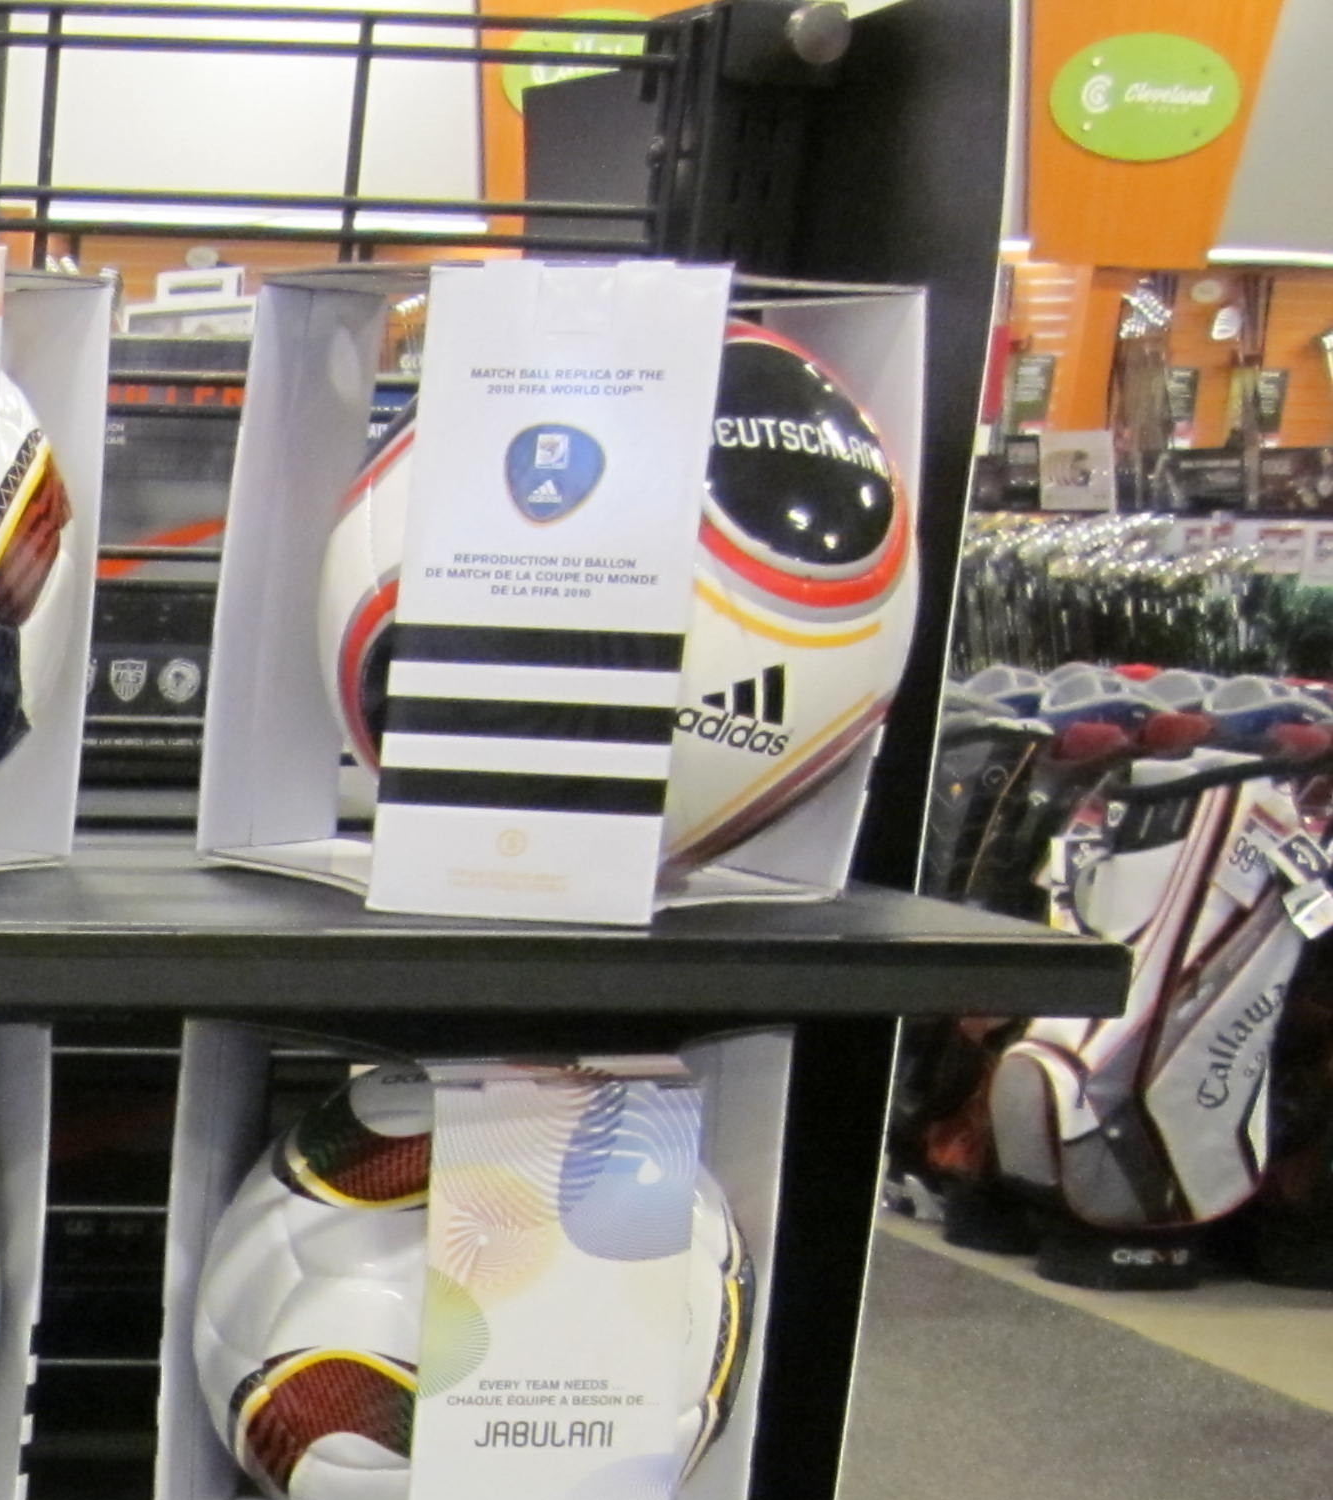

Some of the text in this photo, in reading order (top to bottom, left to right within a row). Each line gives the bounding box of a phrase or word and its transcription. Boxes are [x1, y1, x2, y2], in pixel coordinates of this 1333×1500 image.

[469, 366, 665, 381] MATCH BALL REPLICA OF THE
[486, 383, 515, 395] 2010
[517, 383, 547, 394] FIFA
[549, 383, 601, 395] WORLD
[712, 416, 891, 479] EUTSCHLAND
[452, 552, 637, 569] REPRODUCTION DU BALLON
[424, 566, 659, 585] DE MATCH DE LA COUPE DU MONDE
[489, 583, 591, 598] DE LA FIFA 2010
[675, 707, 790, 757] adidas
[477, 1378, 609, 1391] EVERY TEAM NEEDS
[445, 1394, 503, 1406] CHAQUE
[571, 1394, 623, 1406] BESOIN
[624, 1393, 644, 1406] DE
[474, 1419, 613, 1448] JABULANI
